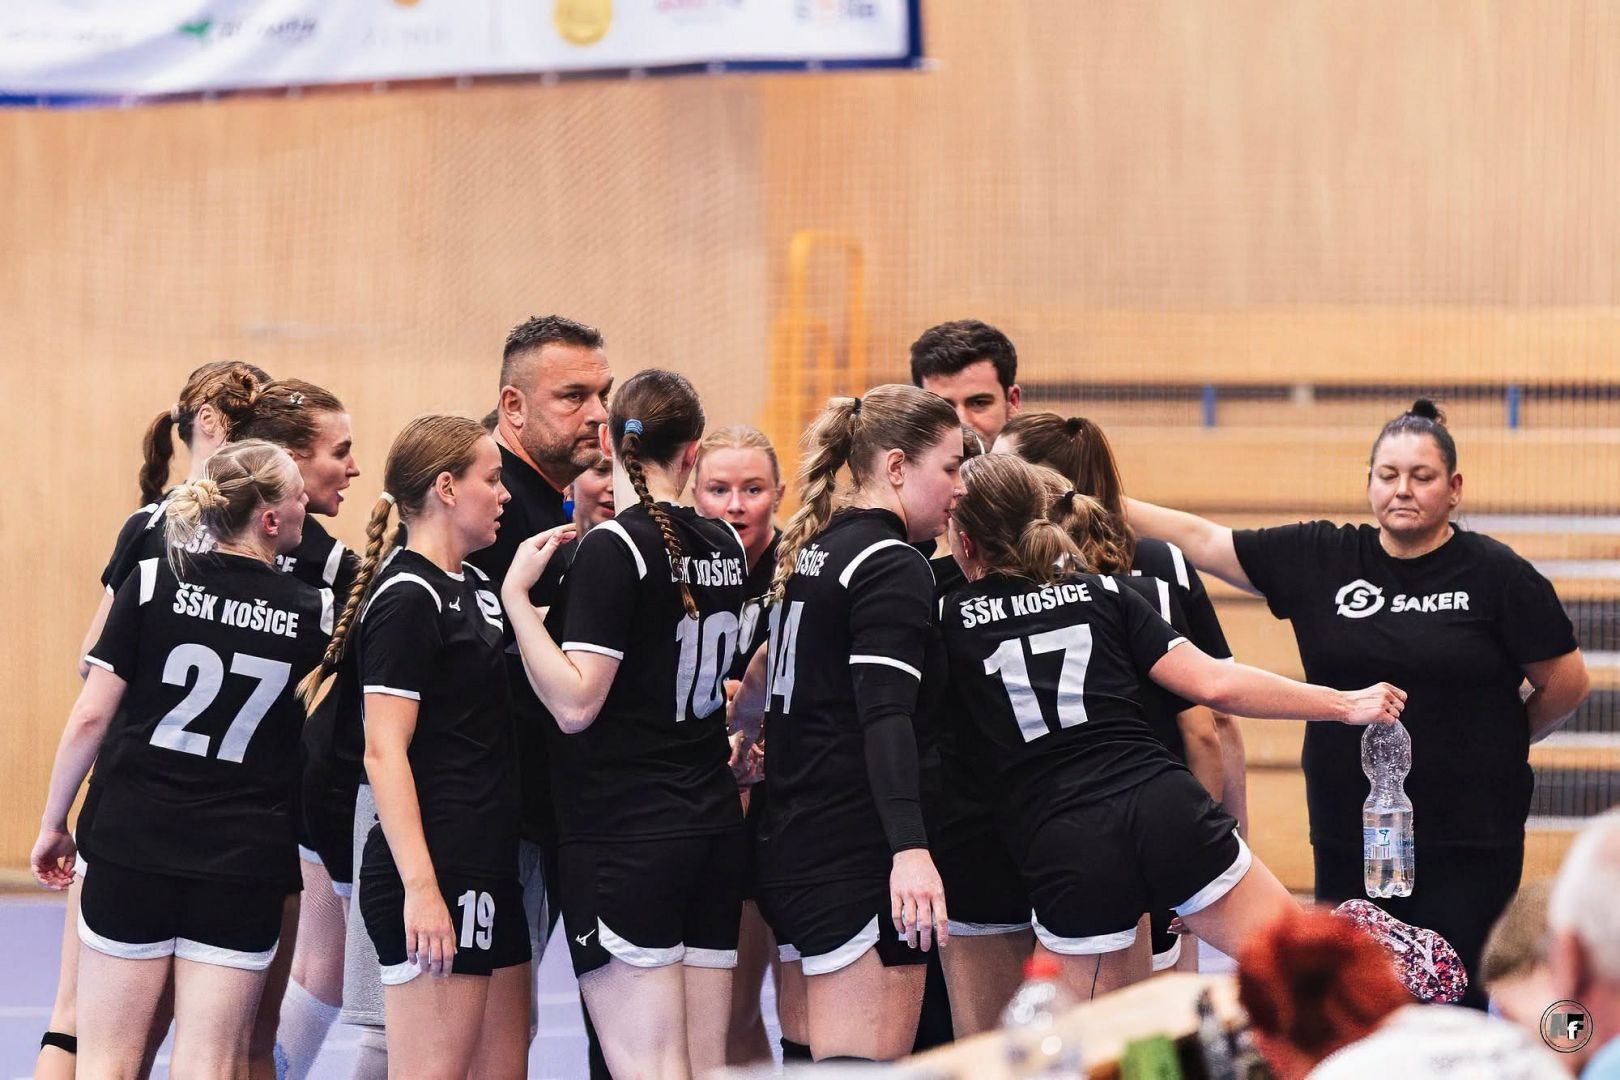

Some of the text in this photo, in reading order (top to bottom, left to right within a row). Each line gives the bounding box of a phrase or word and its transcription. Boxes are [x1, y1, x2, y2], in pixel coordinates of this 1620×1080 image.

[795, 543, 829, 577] OŠICE
[173, 582, 300, 639] ŠŠK KOŠICE
[959, 582, 1093, 629] ŠŠK KOŠICE
[1390, 591, 1470, 613] SAKER
[675, 611, 738, 722] 10
[764, 600, 806, 715] 14
[983, 623, 1093, 743] 17
[149, 643, 292, 764] 27
[457, 890, 496, 950] 19
